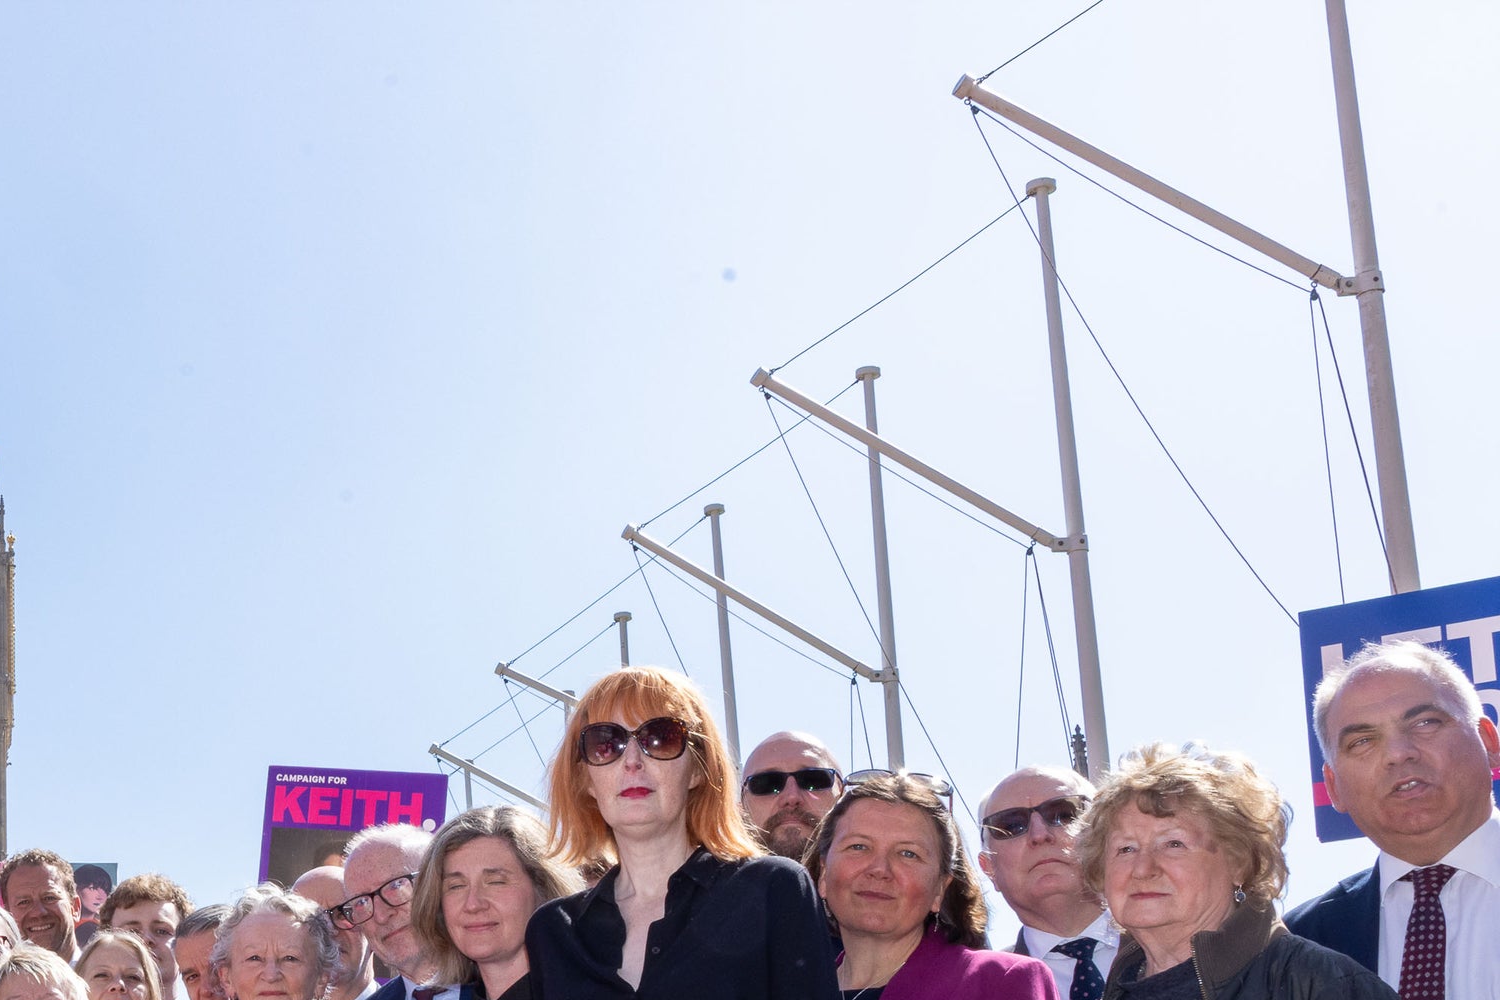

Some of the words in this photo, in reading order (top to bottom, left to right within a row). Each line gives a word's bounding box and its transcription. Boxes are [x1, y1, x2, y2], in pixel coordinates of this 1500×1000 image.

[276, 773, 326, 785] CAMPAIGN
[328, 776, 348, 785] FOR
[272, 785, 436, 832] KEITH.
